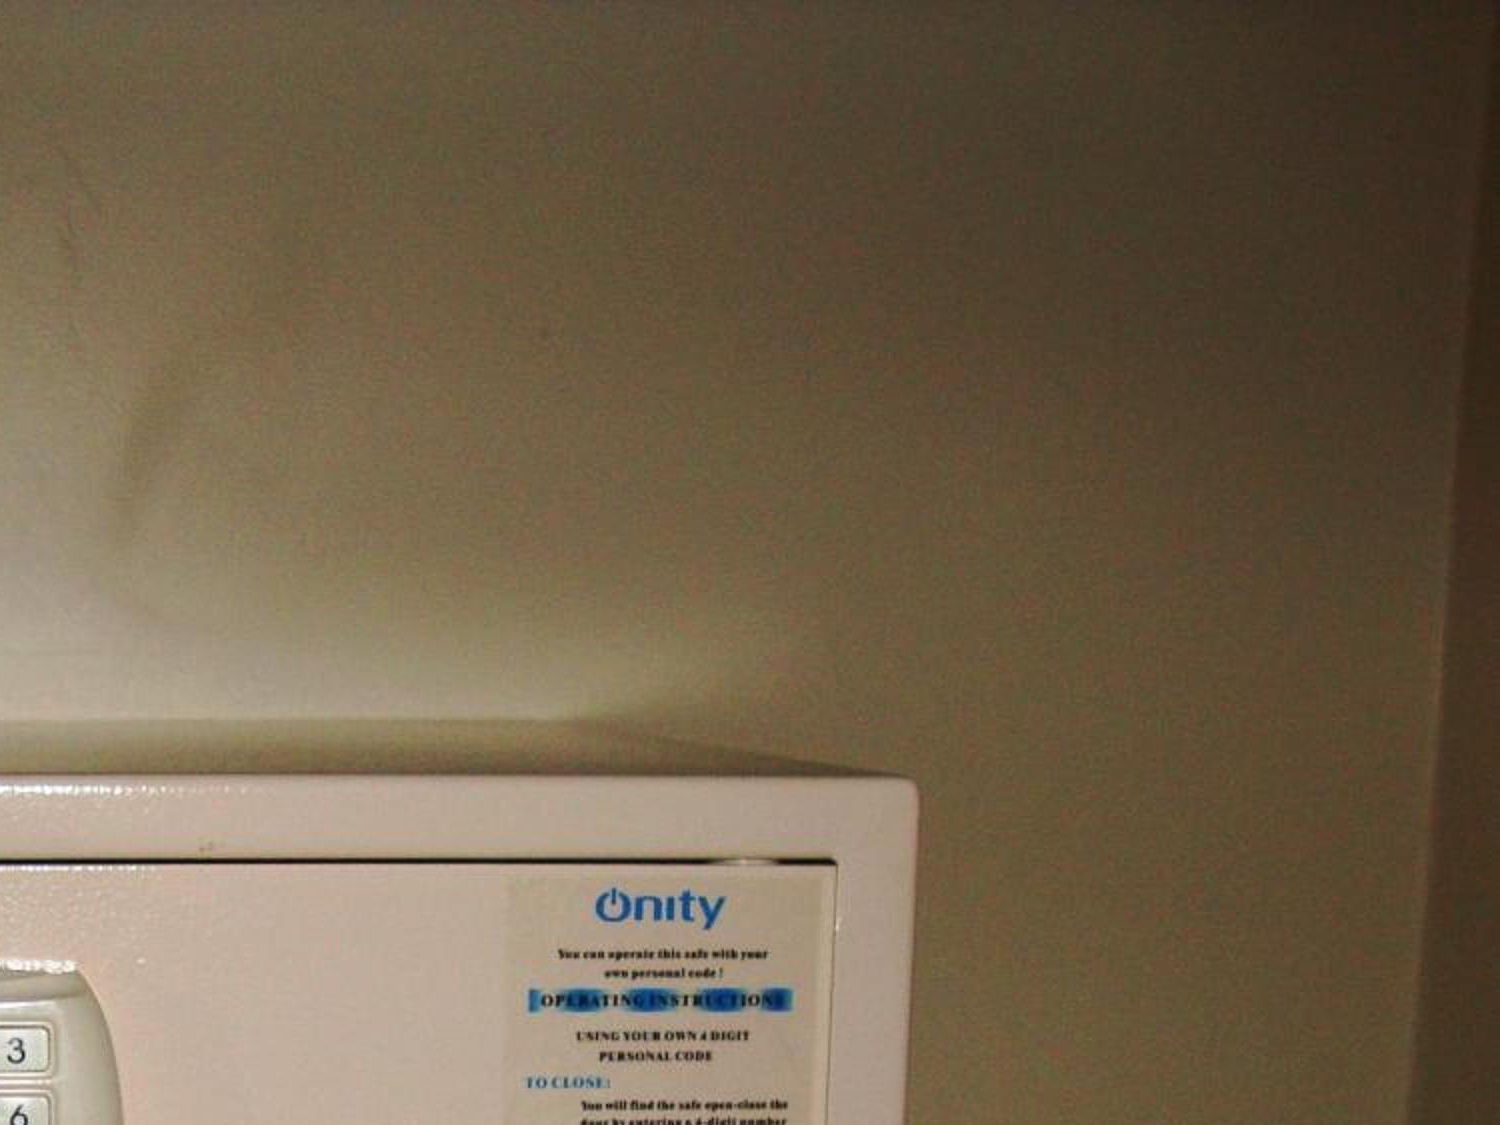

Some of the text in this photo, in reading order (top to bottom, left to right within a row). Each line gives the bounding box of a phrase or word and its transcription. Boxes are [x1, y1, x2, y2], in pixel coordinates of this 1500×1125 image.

[595, 887, 726, 929] Onity
[558, 948, 767, 961] You can operate this safe with your
[604, 970, 628, 978] own
[631, 967, 684, 980] personal
[540, 993, 645, 1008] OPERATING
[576, 1030, 749, 1041] USING YOUR OWN 4 DIGIT
[7, 1037, 26, 1064] 3
[599, 1050, 712, 1062] PERSONAL CODE
[525, 1076, 611, 1089] TO CLOSE:
[581, 1099, 788, 1112] You will find the safe open-close the
